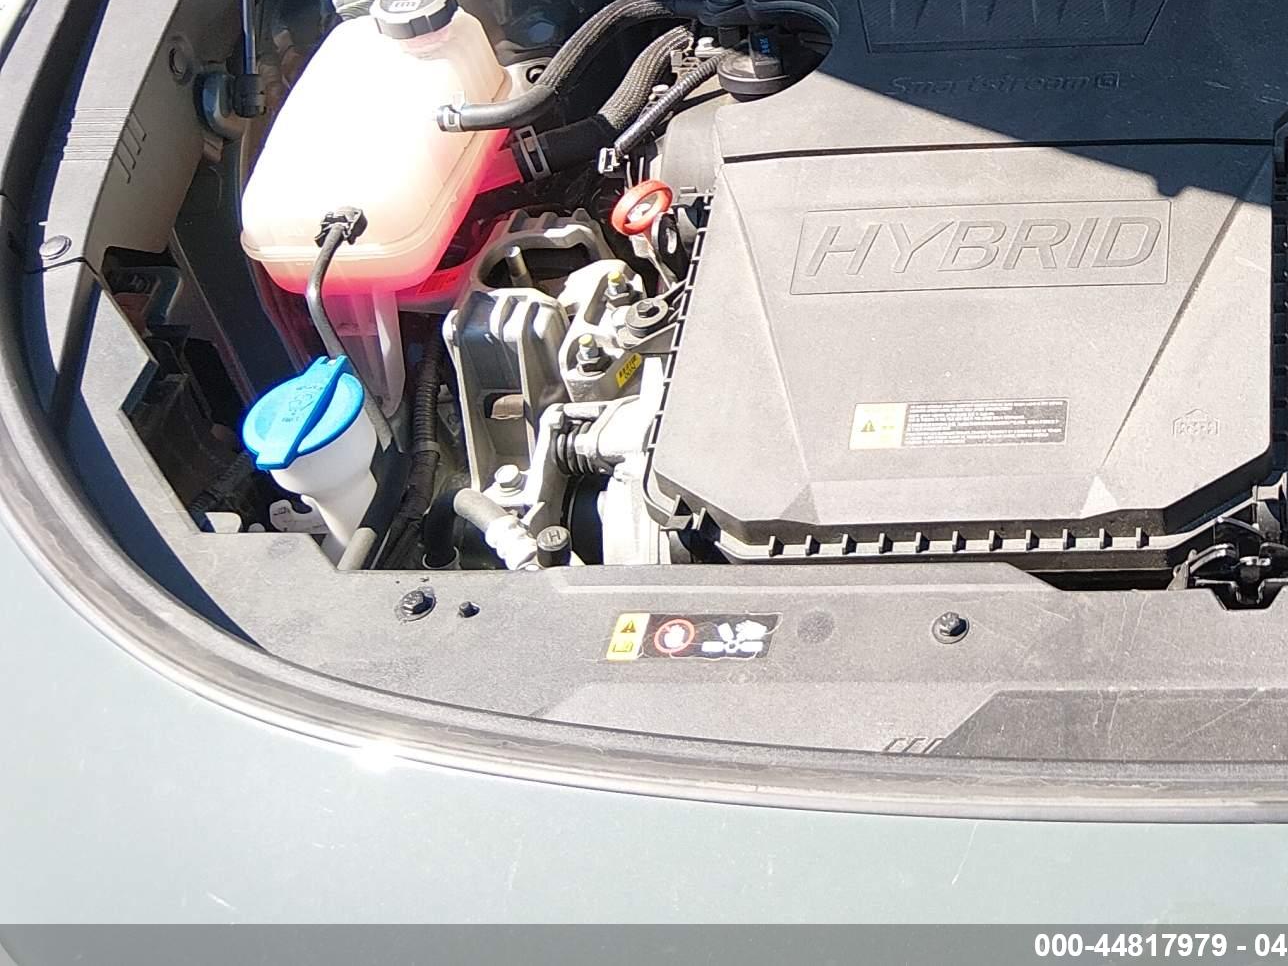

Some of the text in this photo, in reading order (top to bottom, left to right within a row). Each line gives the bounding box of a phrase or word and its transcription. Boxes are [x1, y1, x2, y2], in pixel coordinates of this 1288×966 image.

[890, 74, 1091, 95] Smartstream
[804, 216, 1162, 277] HYBRID
[548, 529, 562, 543] H
